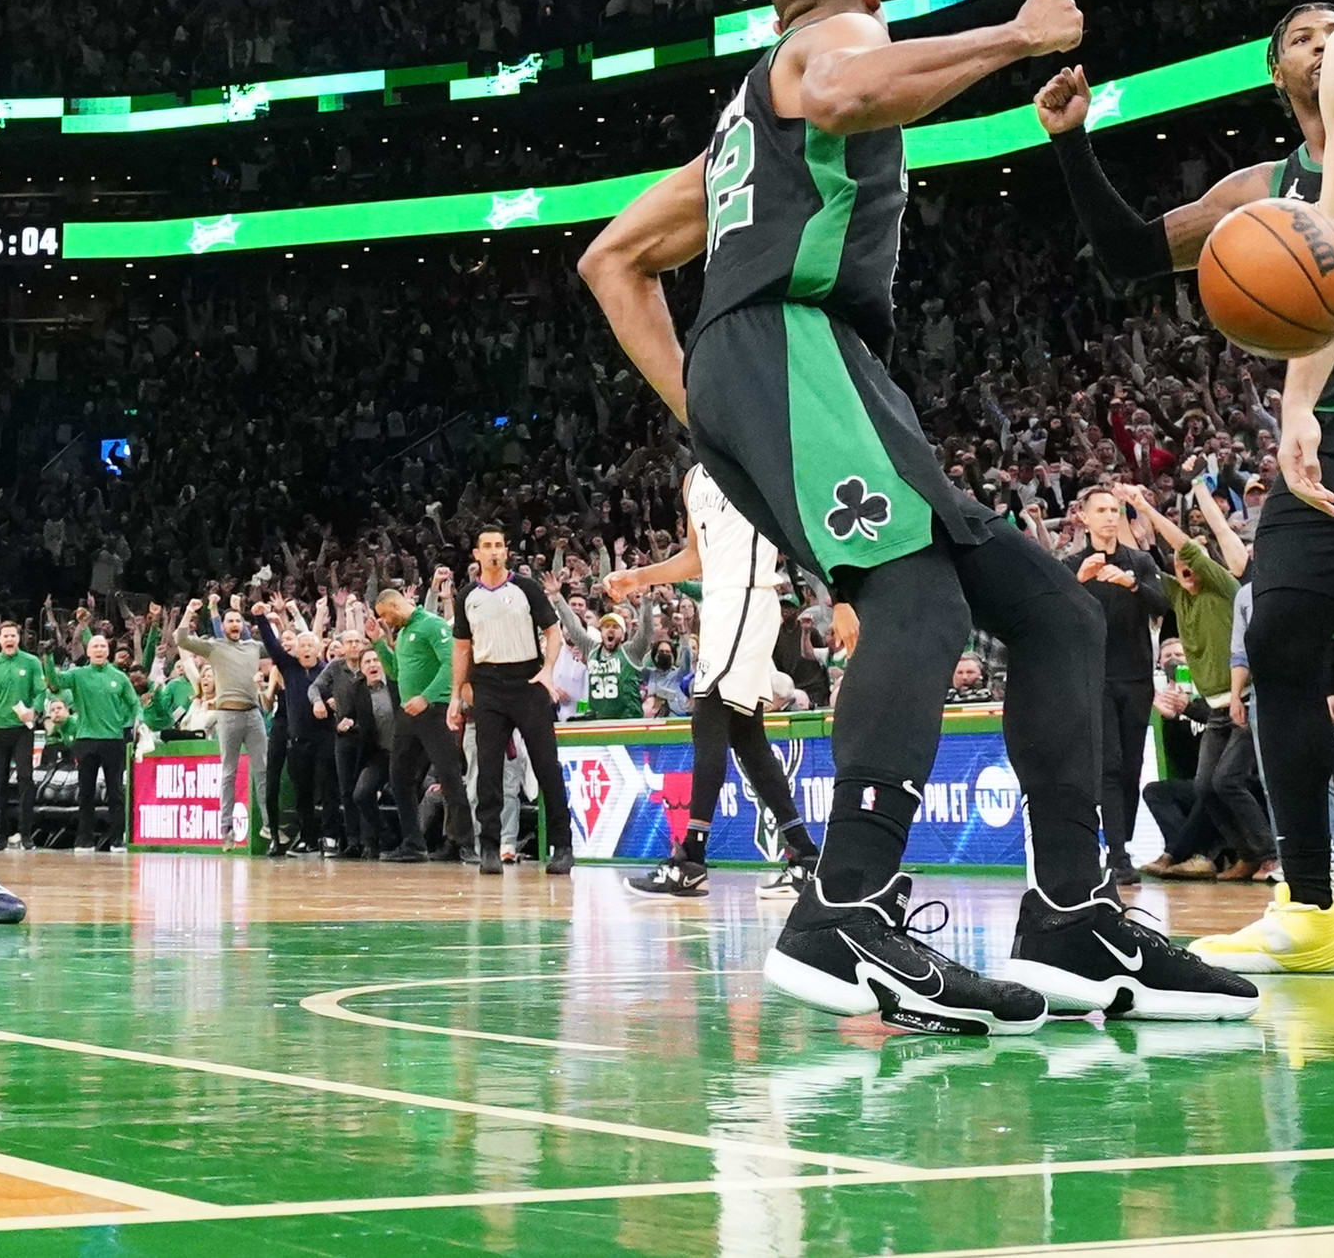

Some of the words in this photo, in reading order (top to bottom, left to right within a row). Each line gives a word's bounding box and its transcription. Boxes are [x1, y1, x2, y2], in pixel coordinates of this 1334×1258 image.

[589, 675, 619, 700] 36
[155, 763, 185, 799] BULLS
[924, 782, 949, 823] PM
[950, 782, 968, 823] ET
[139, 804, 179, 840] TONIGHT
